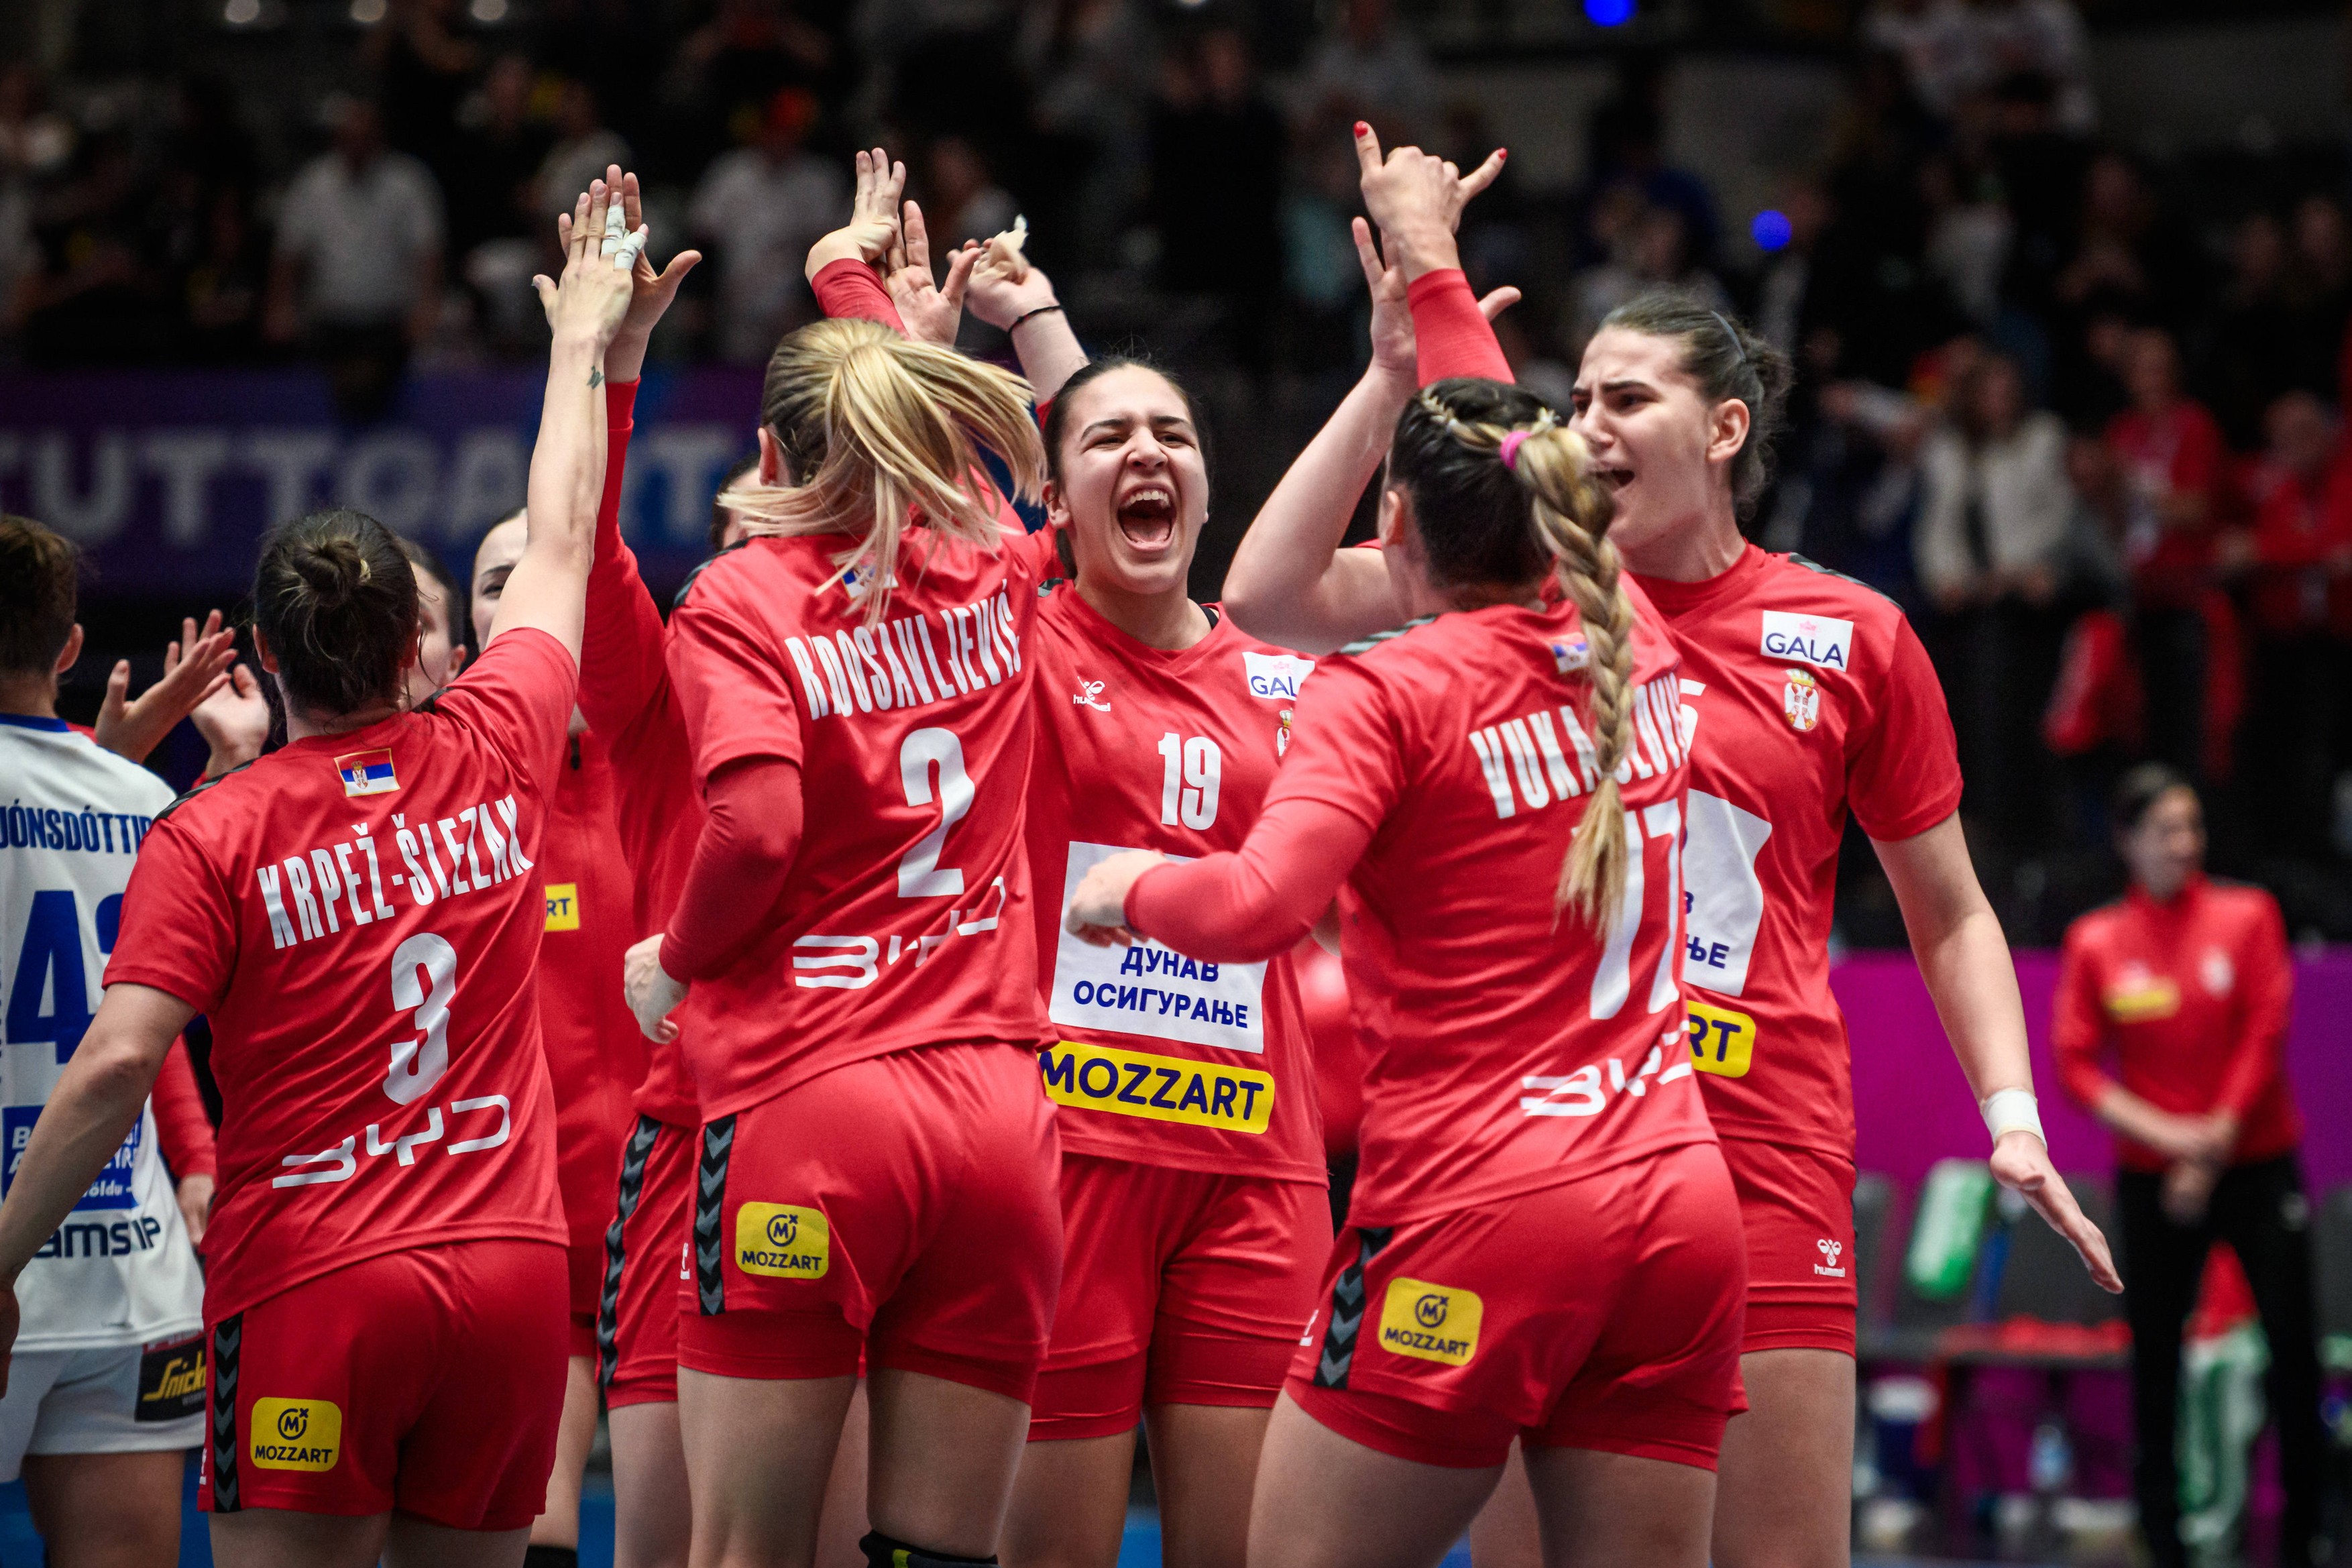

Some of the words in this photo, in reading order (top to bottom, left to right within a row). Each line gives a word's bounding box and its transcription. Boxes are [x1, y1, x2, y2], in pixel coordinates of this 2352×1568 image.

[785, 578, 1021, 721] RDOSAVLJEVIĆ
[1765, 632, 1844, 668] GALA
[1250, 675, 1298, 698] GAL
[1158, 732, 1222, 831] 19
[897, 727, 975, 898] 2
[256, 793, 535, 950] KRPEŽ-ŠLEZAK
[1120, 946, 1220, 983] ДУНАВ
[382, 932, 457, 1105] 3
[1073, 980, 1249, 1029] ОСИГУРАЊЕ
[1039, 1051, 1265, 1121] MOZZART
[272, 1095, 512, 1188] BYD
[742, 1250, 822, 1271] MOZZART
[1384, 1327, 1471, 1357] MOZZART
[254, 1445, 333, 1463] MOZZART
